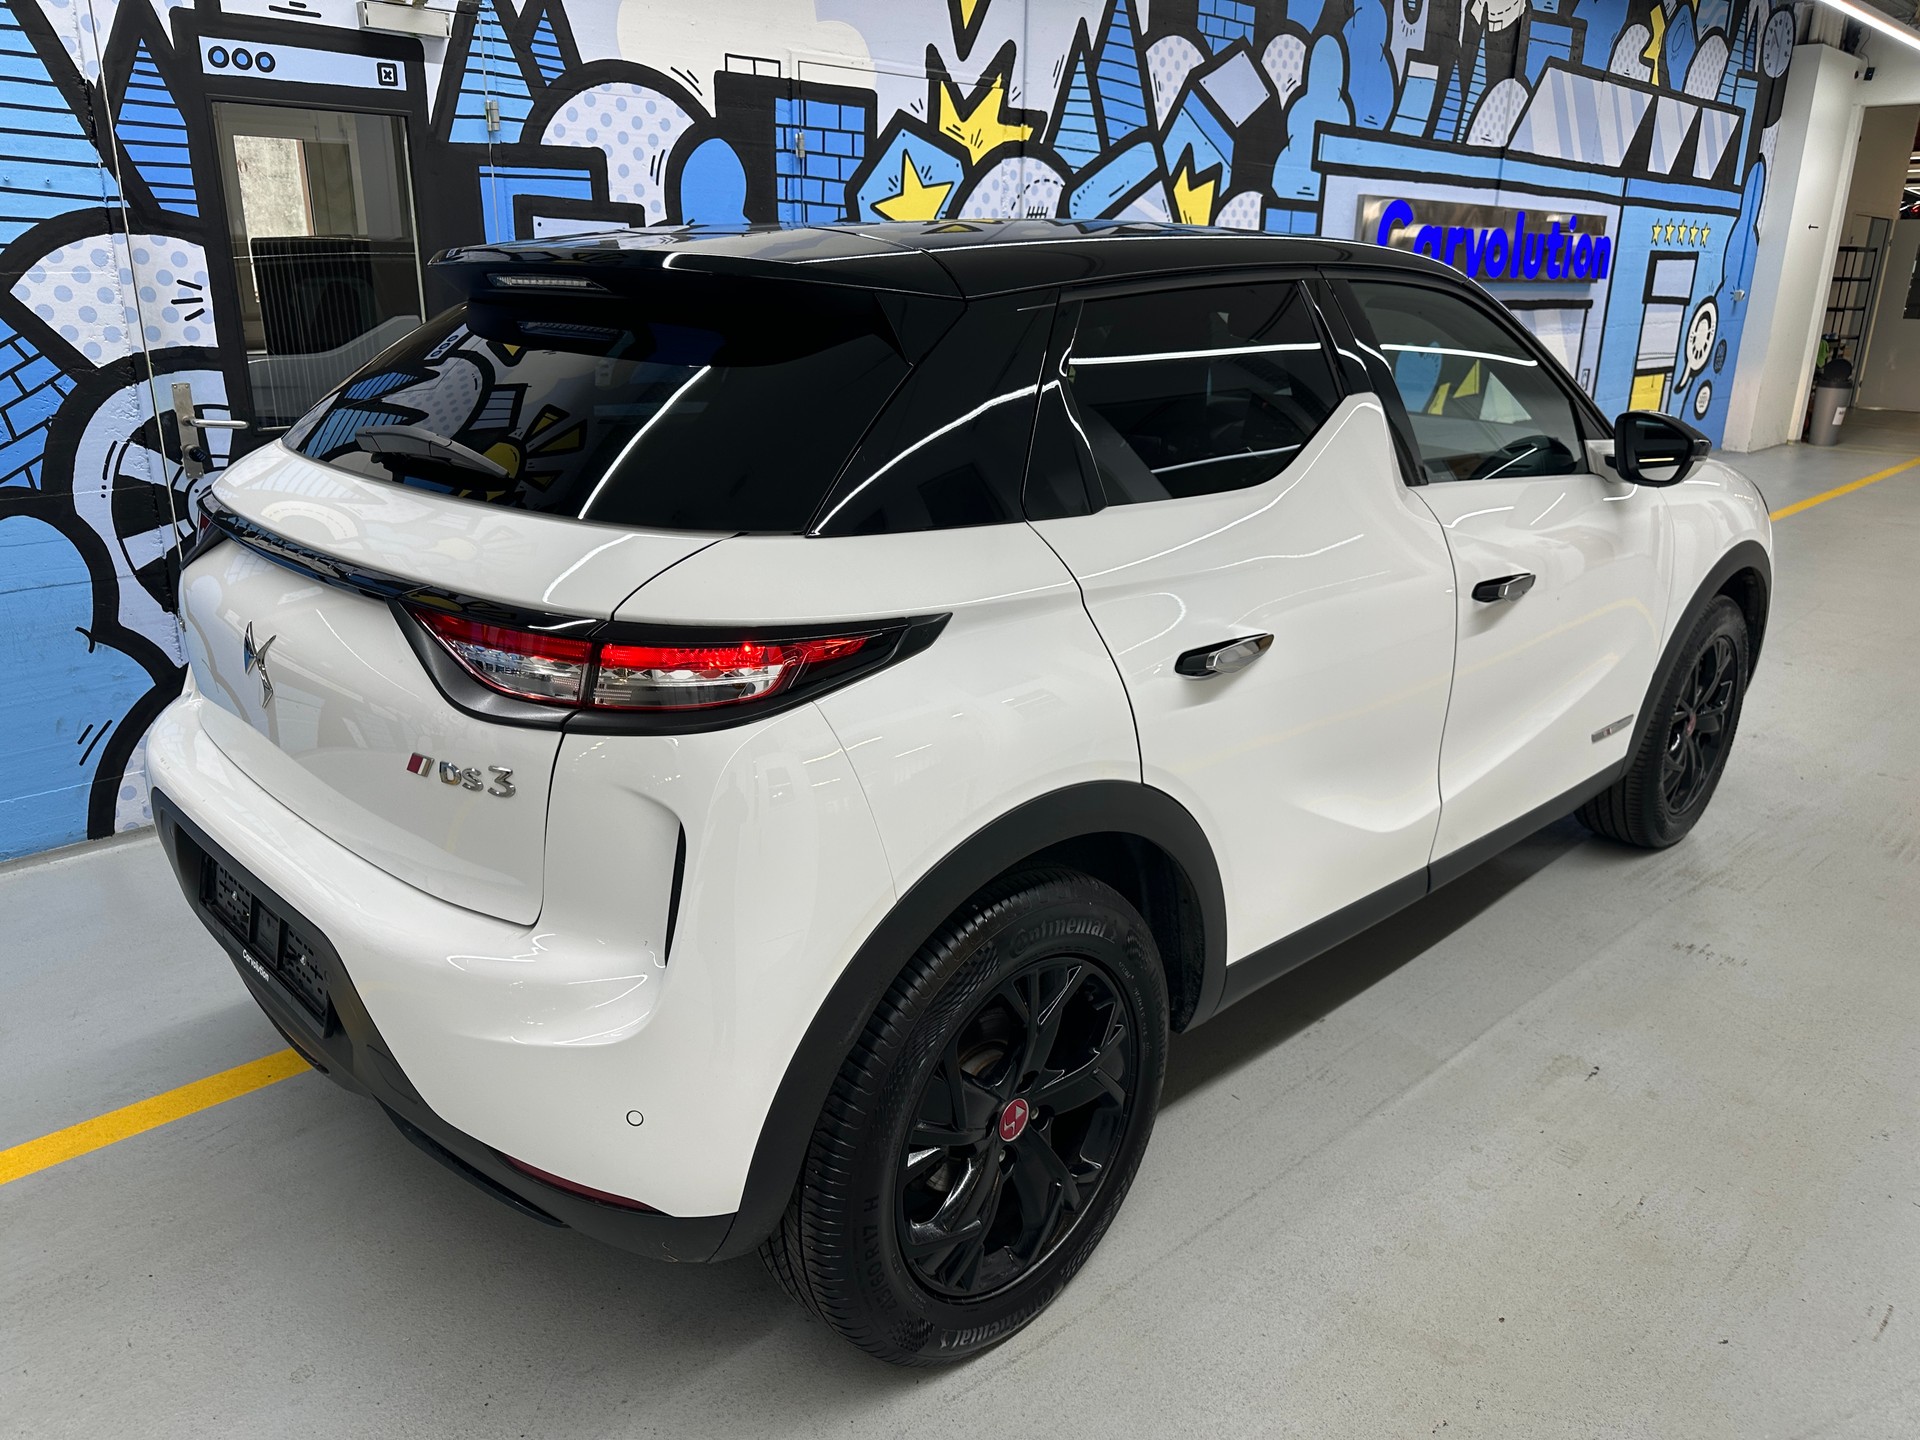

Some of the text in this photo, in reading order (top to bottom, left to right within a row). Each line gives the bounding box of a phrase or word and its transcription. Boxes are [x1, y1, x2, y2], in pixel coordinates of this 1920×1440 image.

[1377, 199, 1611, 279] Carvolution
[1009, 916, 1108, 959] Continental
[242, 948, 270, 982] Carvolution
